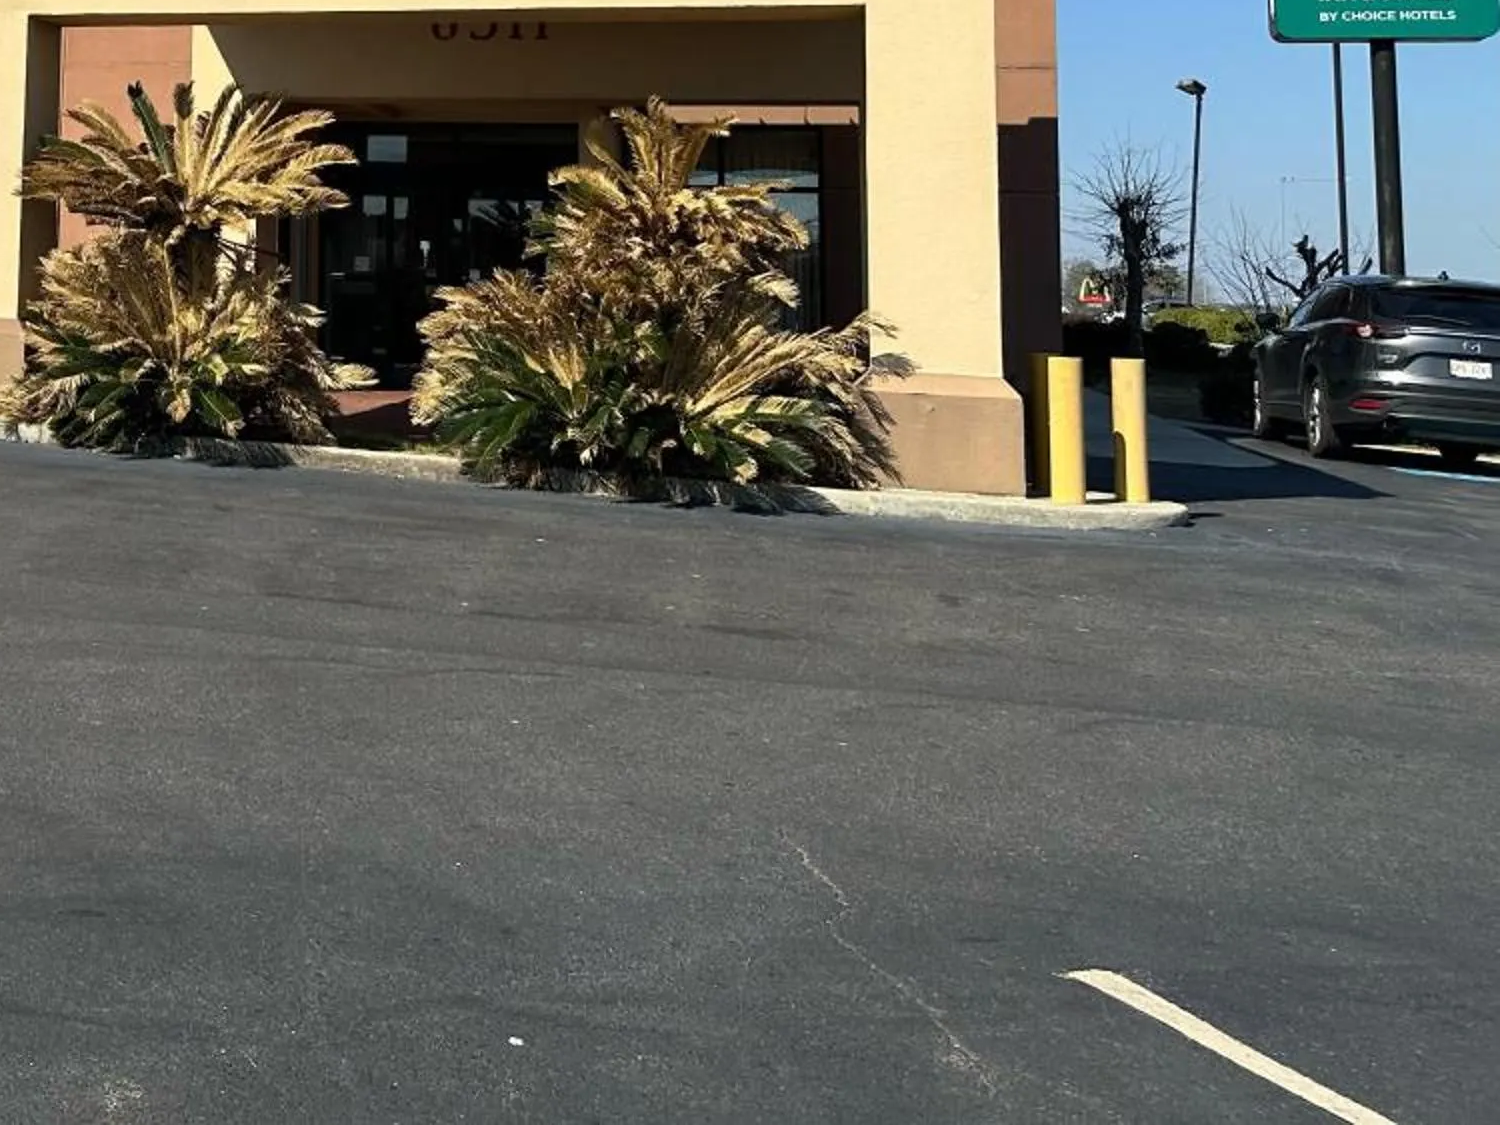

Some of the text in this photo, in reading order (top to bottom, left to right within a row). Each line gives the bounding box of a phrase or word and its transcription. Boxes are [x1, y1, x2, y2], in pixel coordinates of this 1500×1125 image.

[1319, 10, 1457, 22] BY CHOICE HOTELS
